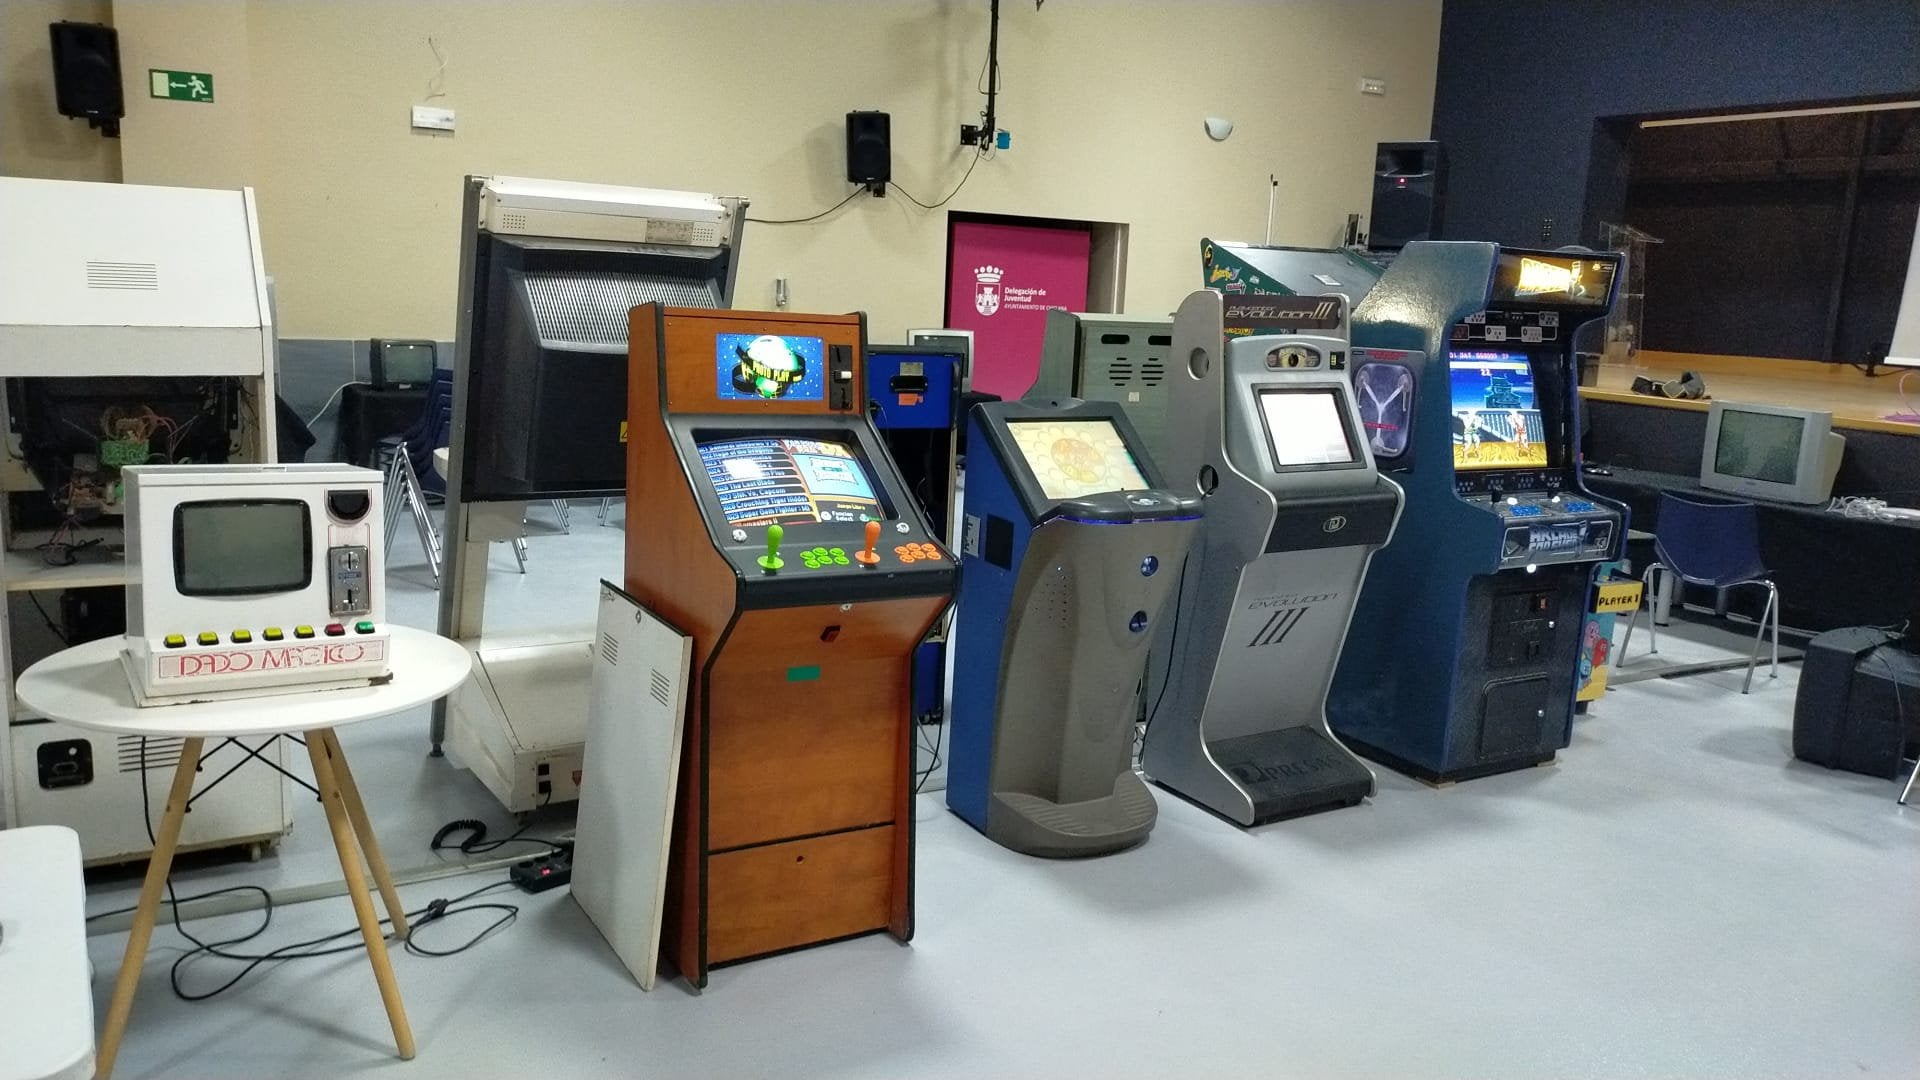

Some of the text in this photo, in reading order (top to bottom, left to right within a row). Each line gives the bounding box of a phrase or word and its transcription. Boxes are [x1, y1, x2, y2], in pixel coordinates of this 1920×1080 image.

[1005, 287, 1046, 296] Delegación de
[736, 499, 769, 508] Crouching
[740, 510, 758, 518] Super
[775, 505, 796, 513] Fighter
[1599, 595, 1632, 607] PLAYER
[180, 653, 253, 676] DADO
